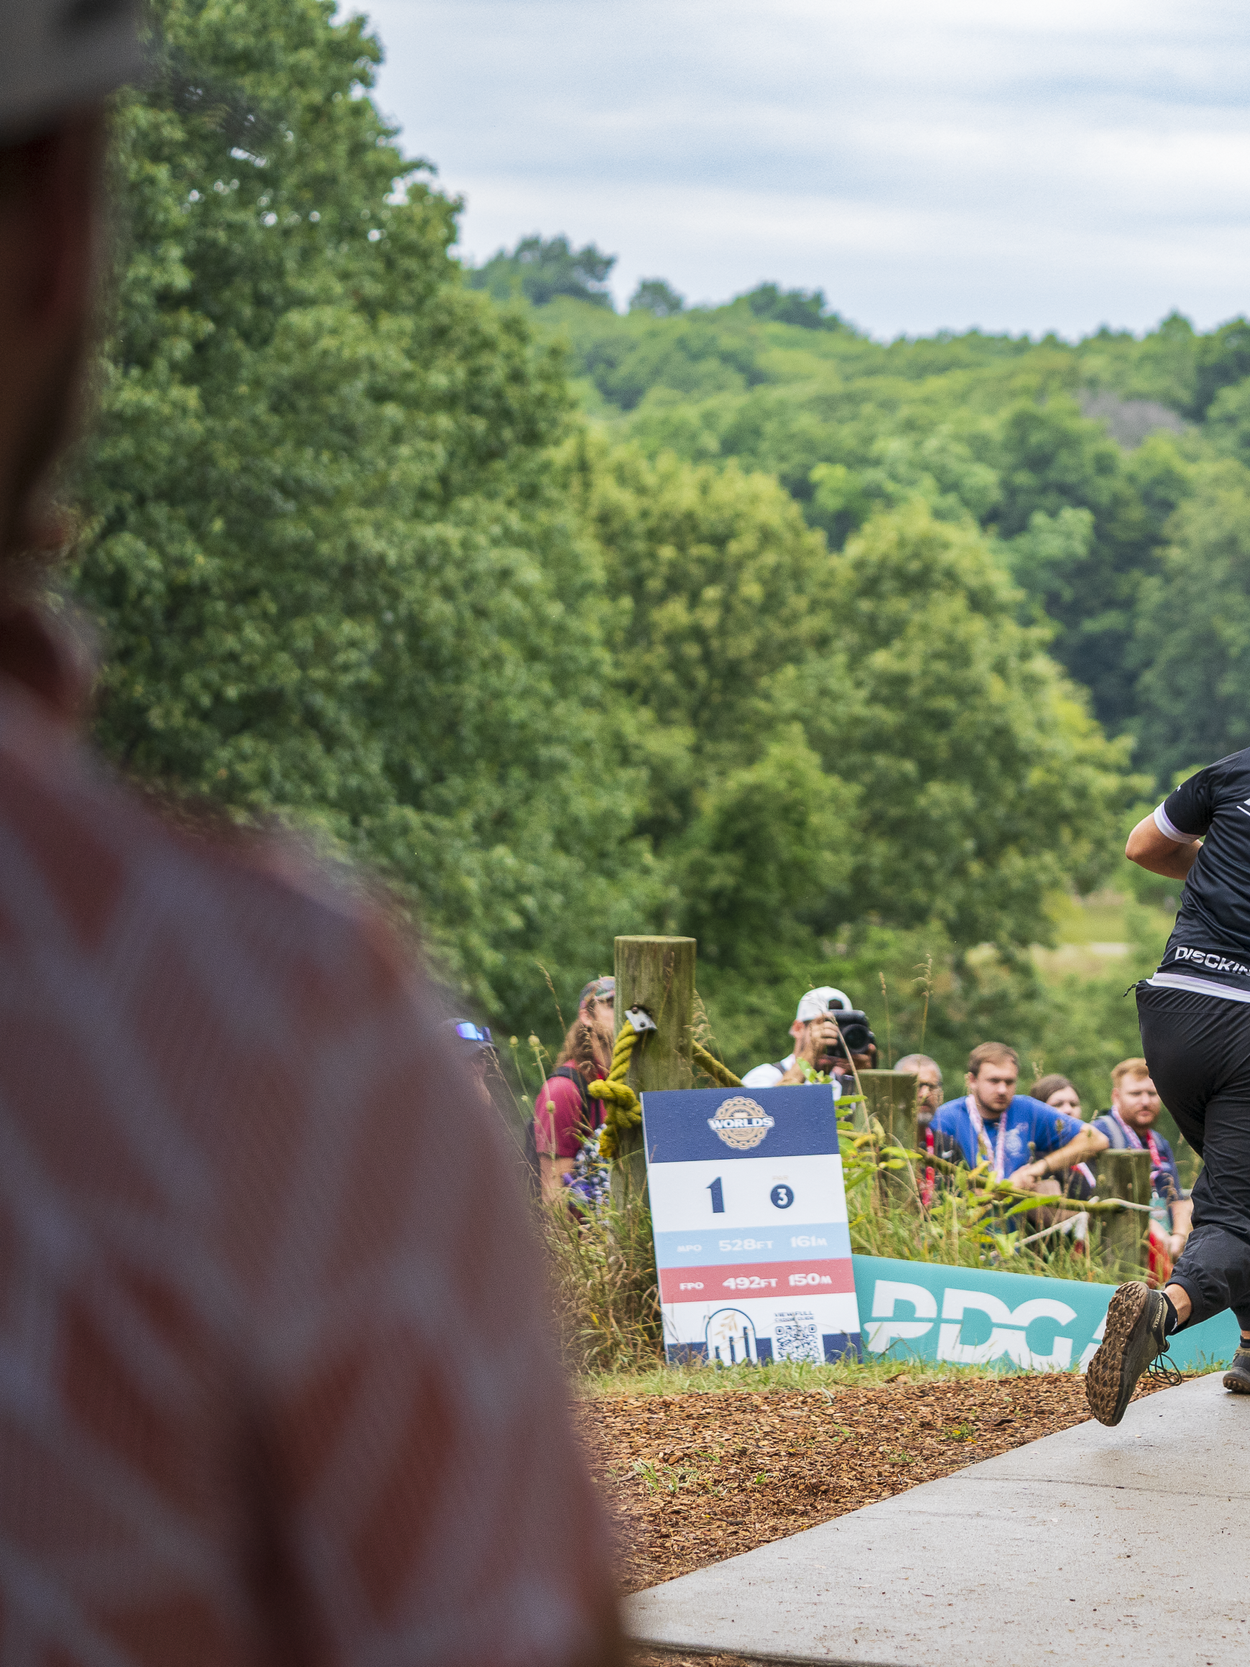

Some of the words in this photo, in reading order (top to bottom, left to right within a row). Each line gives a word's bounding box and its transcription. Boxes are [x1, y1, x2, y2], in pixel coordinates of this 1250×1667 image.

[708, 1117, 774, 1130] WORLDS
[706, 1176, 725, 1214] 1
[777, 1188, 788, 1206] 3
[676, 1243, 703, 1253] MPO
[718, 1239, 774, 1252] 528FT
[790, 1236, 828, 1248] 161M
[679, 1281, 704, 1291] FPO
[722, 1276, 778, 1290] 492FT
[788, 1273, 832, 1287] 150M
